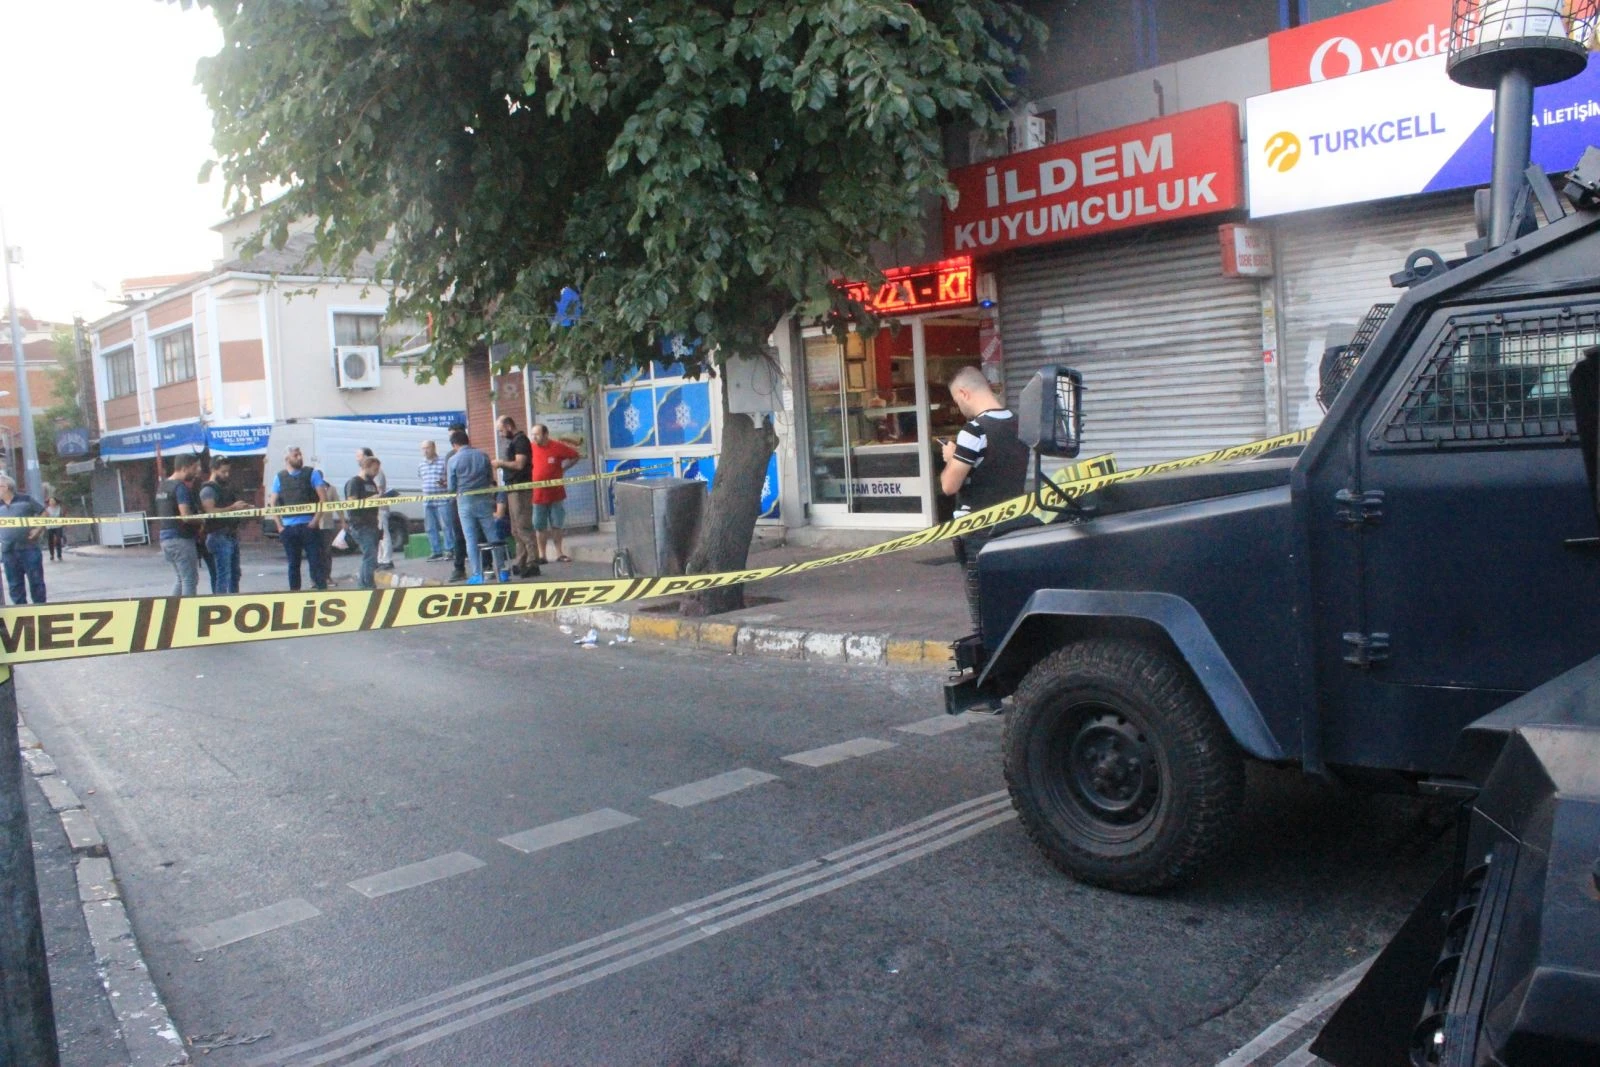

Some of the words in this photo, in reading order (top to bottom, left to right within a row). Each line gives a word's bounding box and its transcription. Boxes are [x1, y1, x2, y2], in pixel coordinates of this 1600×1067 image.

[1309, 112, 1445, 156] TURKCELL
[985, 132, 1174, 208] İLDEM
[954, 172, 1219, 250] KUYUMCULUK
[211, 429, 249, 439] YUSUFUN
[840, 483, 870, 495] UTAM
